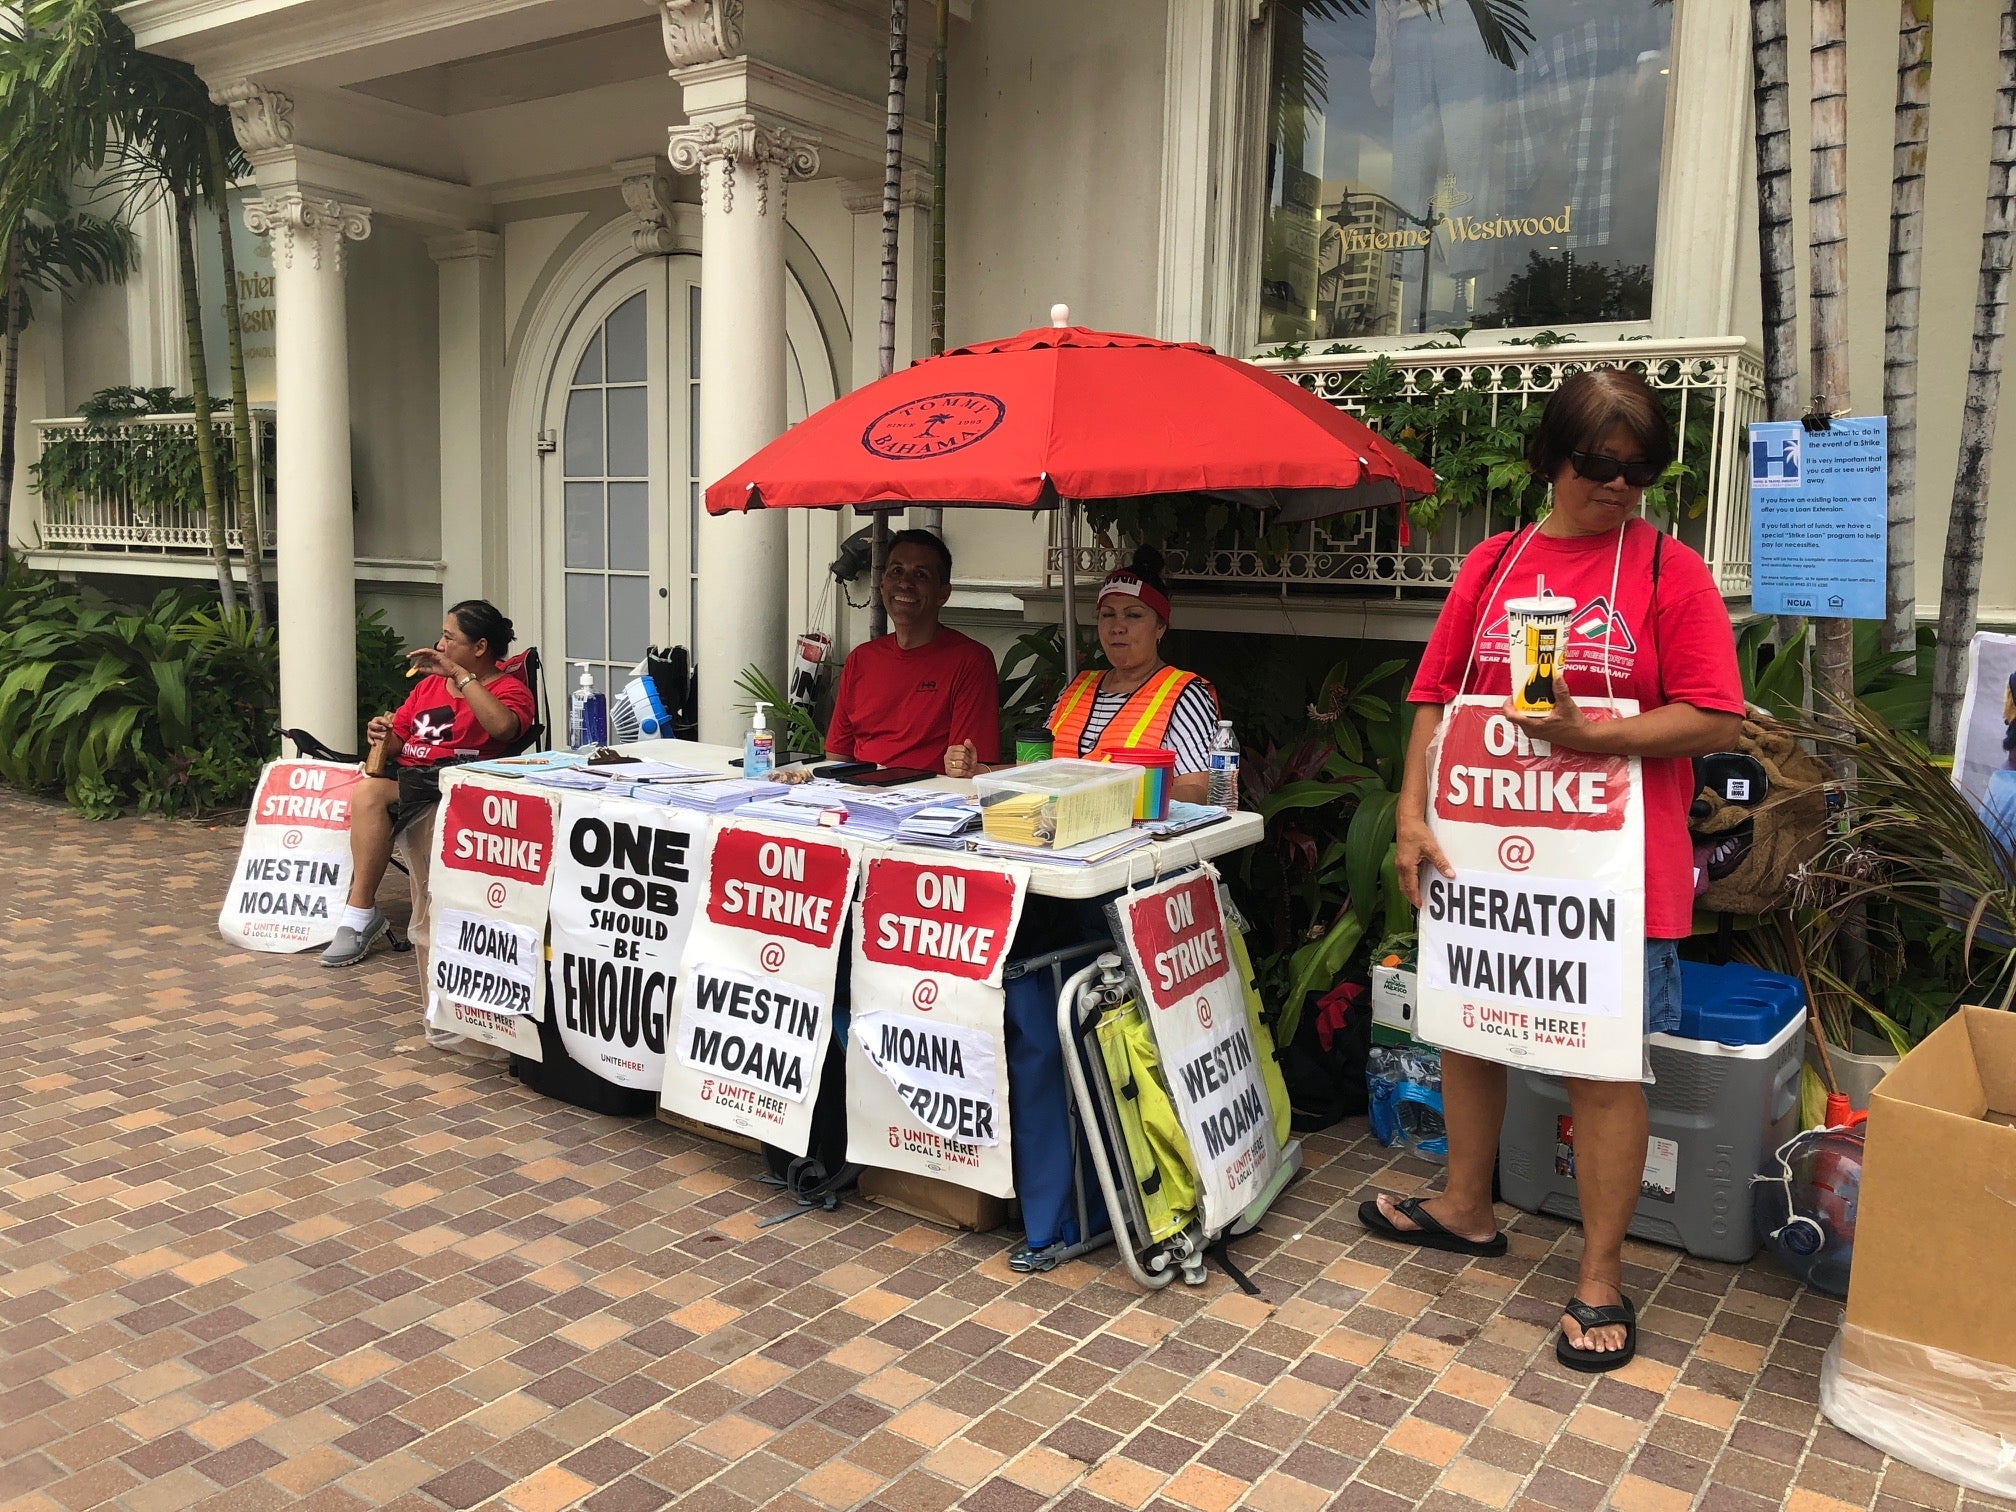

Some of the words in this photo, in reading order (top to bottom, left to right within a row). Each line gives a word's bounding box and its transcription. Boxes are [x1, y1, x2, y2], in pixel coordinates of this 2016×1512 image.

[1332, 226, 1431, 253] Vivienne
[1438, 205, 1572, 244] Westwood
[899, 398, 992, 417] TOMMY
[874, 430, 978, 455] BAHAMA
[1822, 440, 1843, 448] event
[1834, 456, 1867, 464] important
[1865, 465, 1881, 473] right
[1787, 599, 1812, 607] NCUA
[289, 767, 326, 791] ON
[1446, 764, 1608, 814] STRIKE
[262, 795, 347, 822] STRIKE
[482, 795, 518, 830] ON
[282, 829, 303, 849] @
[454, 828, 543, 873] STRIKE
[570, 816, 691, 883] ONE
[1497, 835, 1535, 872] @
[246, 858, 340, 886] WESTIN
[757, 841, 806, 882] ON
[239, 891, 329, 919] MOANA
[487, 882, 507, 908] @
[580, 873, 679, 916] JOB
[721, 878, 833, 934] STRIKE
[915, 871, 965, 913] ON
[589, 909, 668, 941] SHOULD
[1165, 890, 1194, 933] ON
[1429, 879, 1616, 942] SHERATON
[253, 922, 280, 932] UNITE
[282, 924, 311, 936] HERE!
[458, 920, 519, 966] MOANA
[876, 913, 995, 965] STRIKE
[613, 938, 641, 962] BE
[760, 942, 785, 973] @
[1154, 929, 1223, 992] STRIKE
[436, 960, 531, 1013] SURFRIDER
[1447, 943, 1587, 1005] WAIKIKI
[696, 974, 820, 1042] WESTIN
[912, 978, 938, 1011] @
[464, 1005, 492, 1021] UNITE
[494, 1013, 516, 1031] HERE!
[465, 1016, 487, 1028] LOCAL
[1196, 995, 1213, 1030] @
[1480, 1006, 1529, 1028] UNITE
[1534, 1016, 1586, 1037] HERE!
[879, 1023, 965, 1079] MOANA
[1480, 1022, 1518, 1039] LOCAL
[1522, 1030, 1529, 1040] 5
[1535, 1032, 1586, 1048] HAWAII
[600, 1053, 645, 1072] UNITEHERE!
[689, 1027, 802, 1094] MOANA
[1179, 1027, 1251, 1104] WESTIN
[715, 1096, 745, 1112] LOCAL
[747, 1105, 753, 1114] 5
[755, 1107, 784, 1125] HAWAII
[718, 1082, 755, 1104] UNITE
[757, 1094, 788, 1116] HERE!
[1200, 1082, 1264, 1160] MOANA
[903, 1128, 940, 1148] UNITE
[943, 1138, 979, 1158] HERE!
[904, 1143, 934, 1157] LOCAL
[936, 1149, 942, 1158] 5
[945, 1151, 979, 1168] HAWAII
[1233, 1149, 1252, 1174] UNITE
